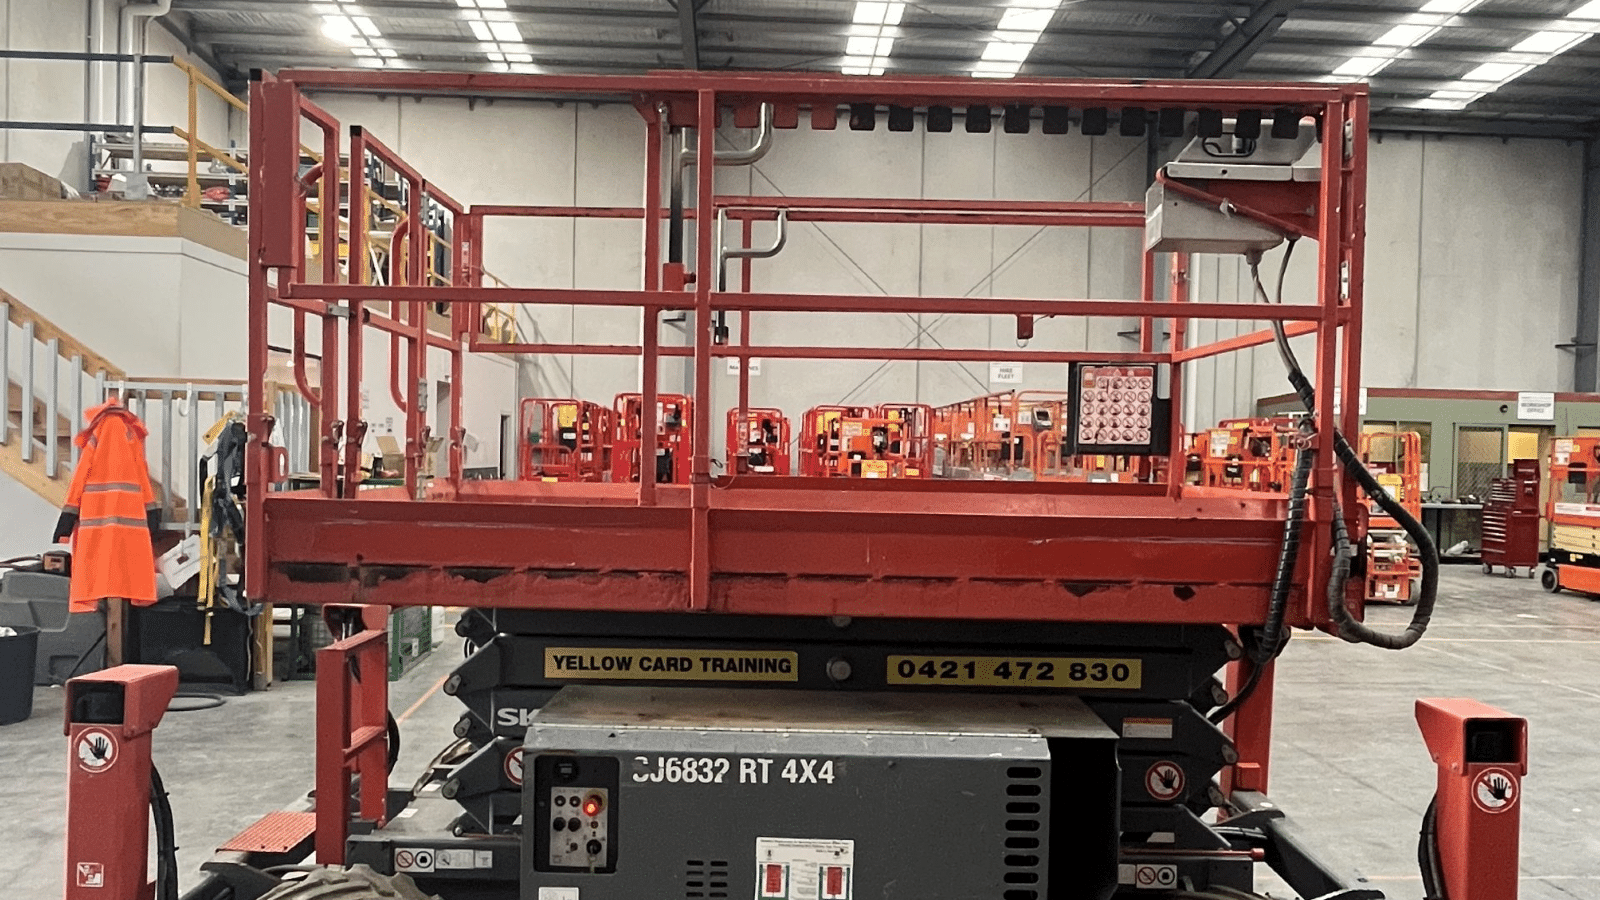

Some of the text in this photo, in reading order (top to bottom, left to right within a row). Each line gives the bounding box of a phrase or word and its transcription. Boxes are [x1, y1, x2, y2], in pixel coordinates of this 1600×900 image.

[553, 655, 792, 673] YELLOW CARD TRAINING
[897, 659, 1130, 682] 0421 472 830
[739, 757, 774, 784] RT
[781, 758, 835, 784] 4X4
